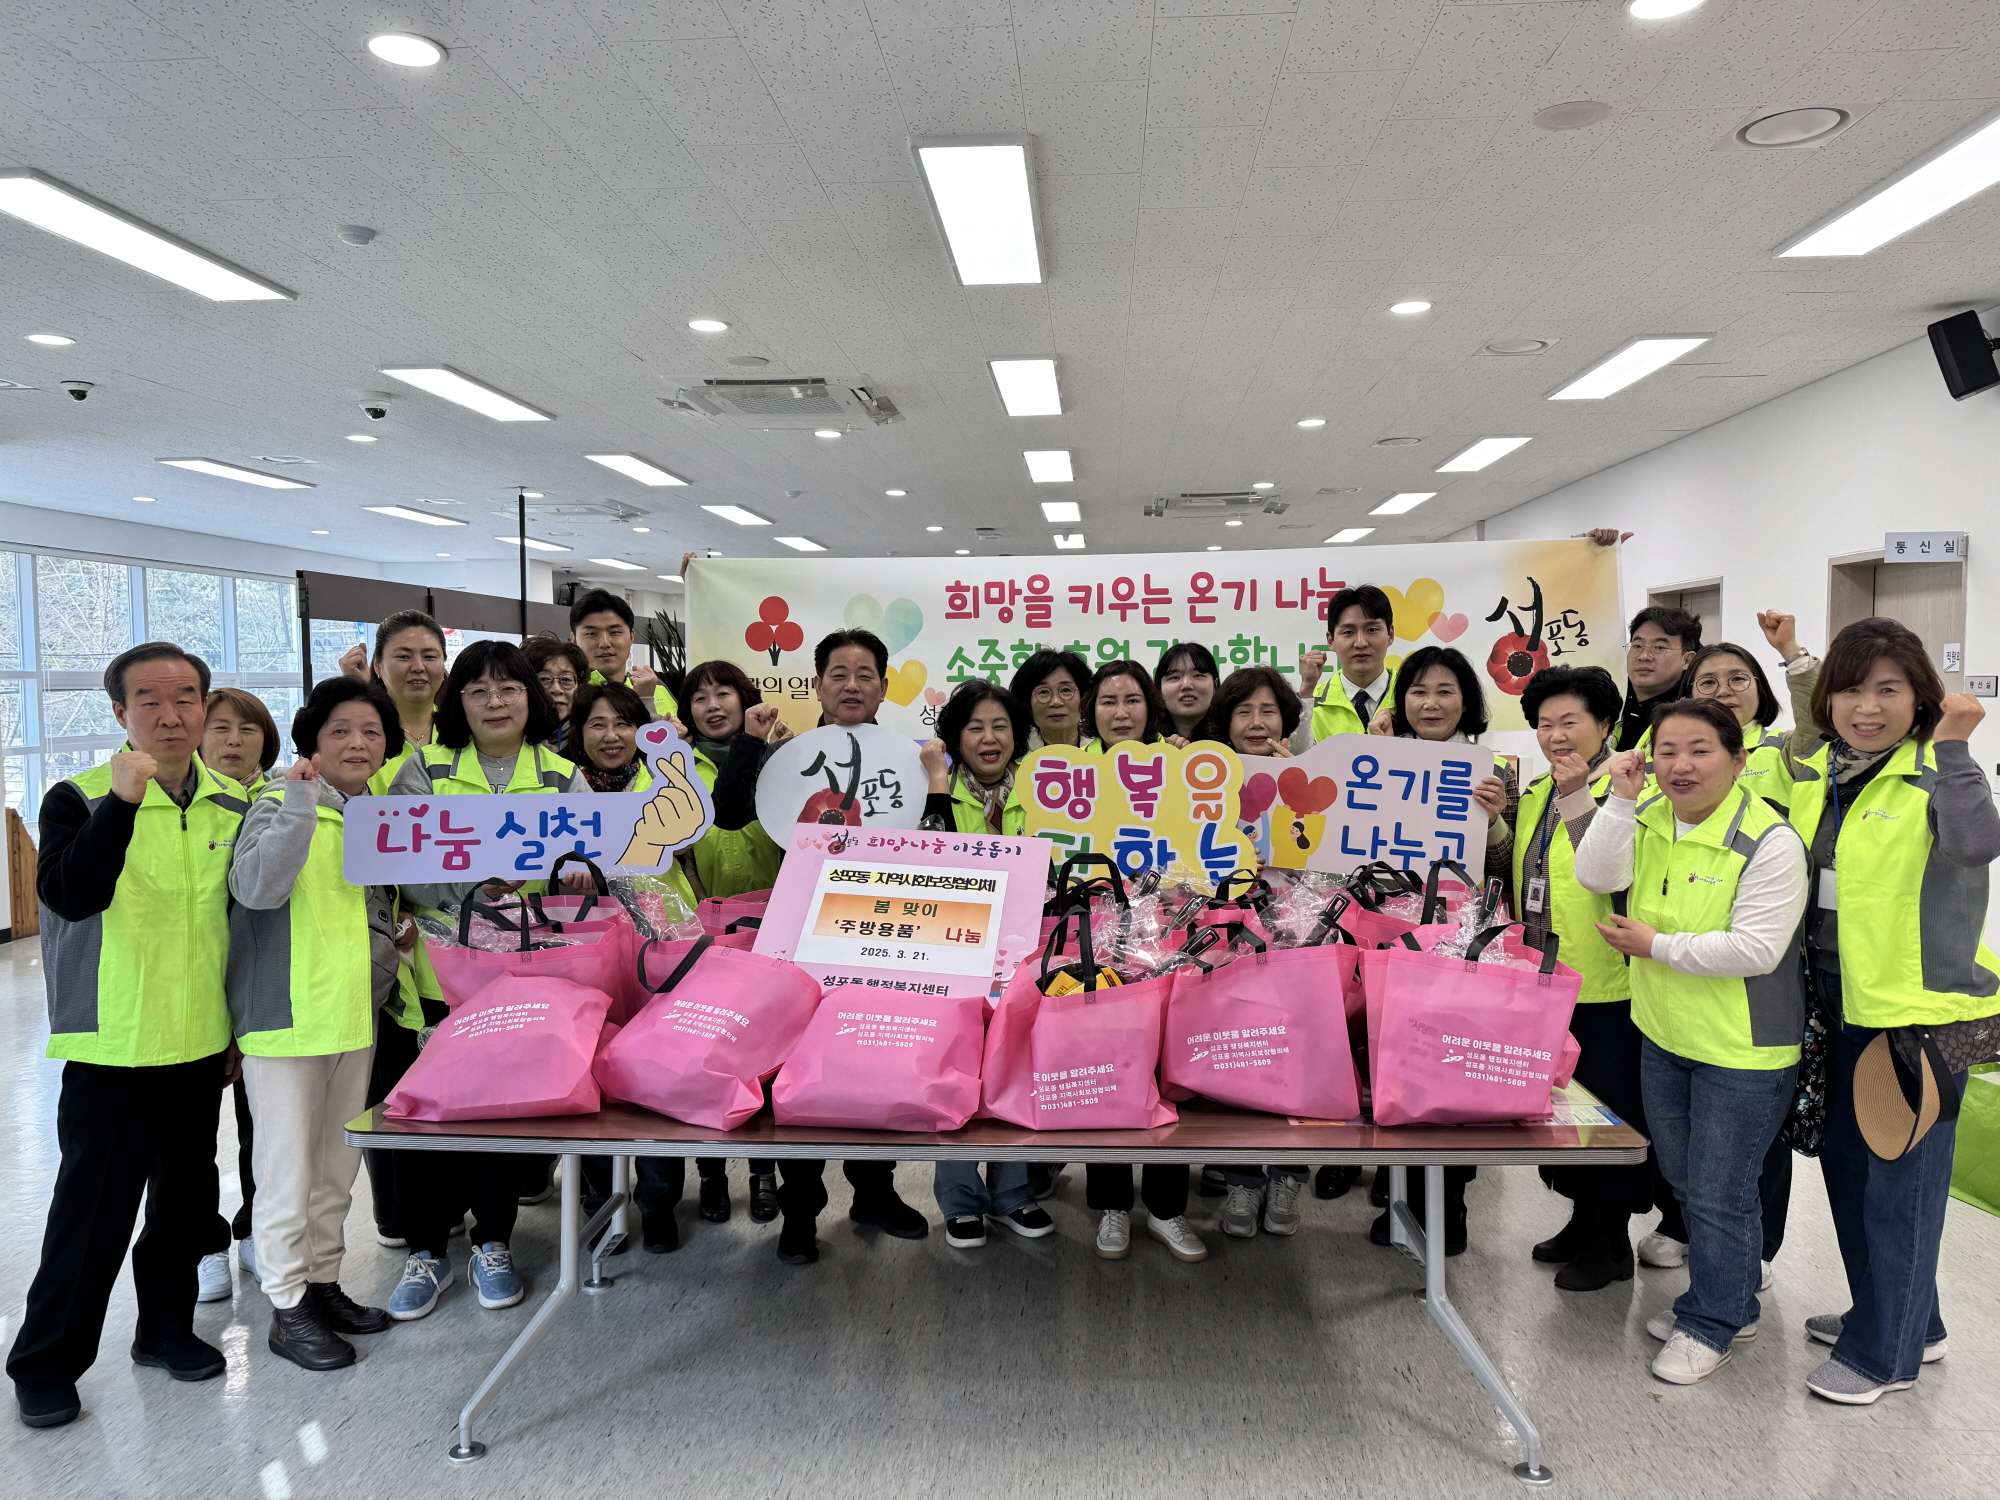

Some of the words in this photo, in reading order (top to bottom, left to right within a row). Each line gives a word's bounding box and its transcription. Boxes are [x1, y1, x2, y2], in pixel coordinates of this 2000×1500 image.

[945, 574, 1054, 628] 희망을
[1068, 573, 1173, 624] 키우는
[1187, 571, 1257, 624] 온기
[1275, 567, 1346, 621] 나눔
[1034, 753, 1228, 821] 행복을
[1346, 755, 1473, 821] 온기를
[377, 804, 482, 870] 나눔
[496, 806, 602, 870] 실천
[867, 836, 947, 854] 희망나눔
[952, 841, 1022, 859] 이웃돕기
[1341, 822, 1467, 870] 나누고
[829, 869, 871, 884] 성포동
[875, 872, 996, 893] 지역사회보장협의체
[873, 900, 890, 914] 봄
[902, 902, 938, 917] 맞이
[946, 928, 982, 944] 나눔
[860, 947, 891, 958] 2025.
[897, 950, 907, 959] 3.
[913, 951, 929, 961] 21.
[837, 1011, 864, 1021] 어려운
[865, 1013, 892, 1023] 이웃을
[893, 1015, 937, 1027] 알려주세요
[859, 1023, 877, 1031] 성포동
[879, 1024, 917, 1032] 행정복지센터
[1187, 1033, 1211, 1045] 어려운
[1213, 1030, 1240, 1041] 이웃을
[1241, 1025, 1287, 1039] 알려주세요
[863, 1040, 914, 1048] 031)481-5609
[1230, 1040, 1269, 1050] 행정복지센터
[1442, 1034, 1471, 1048] 어려운
[1473, 1039, 1502, 1053] 이웃을
[1503, 1044, 1552, 1061] 알려주세요
[1220, 1059, 1272, 1069] 031)481-5609
[1466, 1051, 1486, 1061] 성포동
[1489, 1054, 1529, 1068] 행정복지센터
[1042, 1070, 1068, 1082] 이웃을
[1069, 1063, 1115, 1078] 알려주세요
[1465, 1061, 1485, 1071] 성포동
[1487, 1064, 1550, 1081] 지역사회보장협의체
[1472, 1072, 1527, 1087] 031)481-5609
[1038, 1084, 1057, 1093] 성포동
[1059, 1078, 1097, 1090] 행정복지센터
[1039, 1093, 1058, 1101] 성포동
[1059, 1084, 1117, 1099] 지역사회보장협의체
[1047, 1097, 1099, 1110] 031)481-5609
